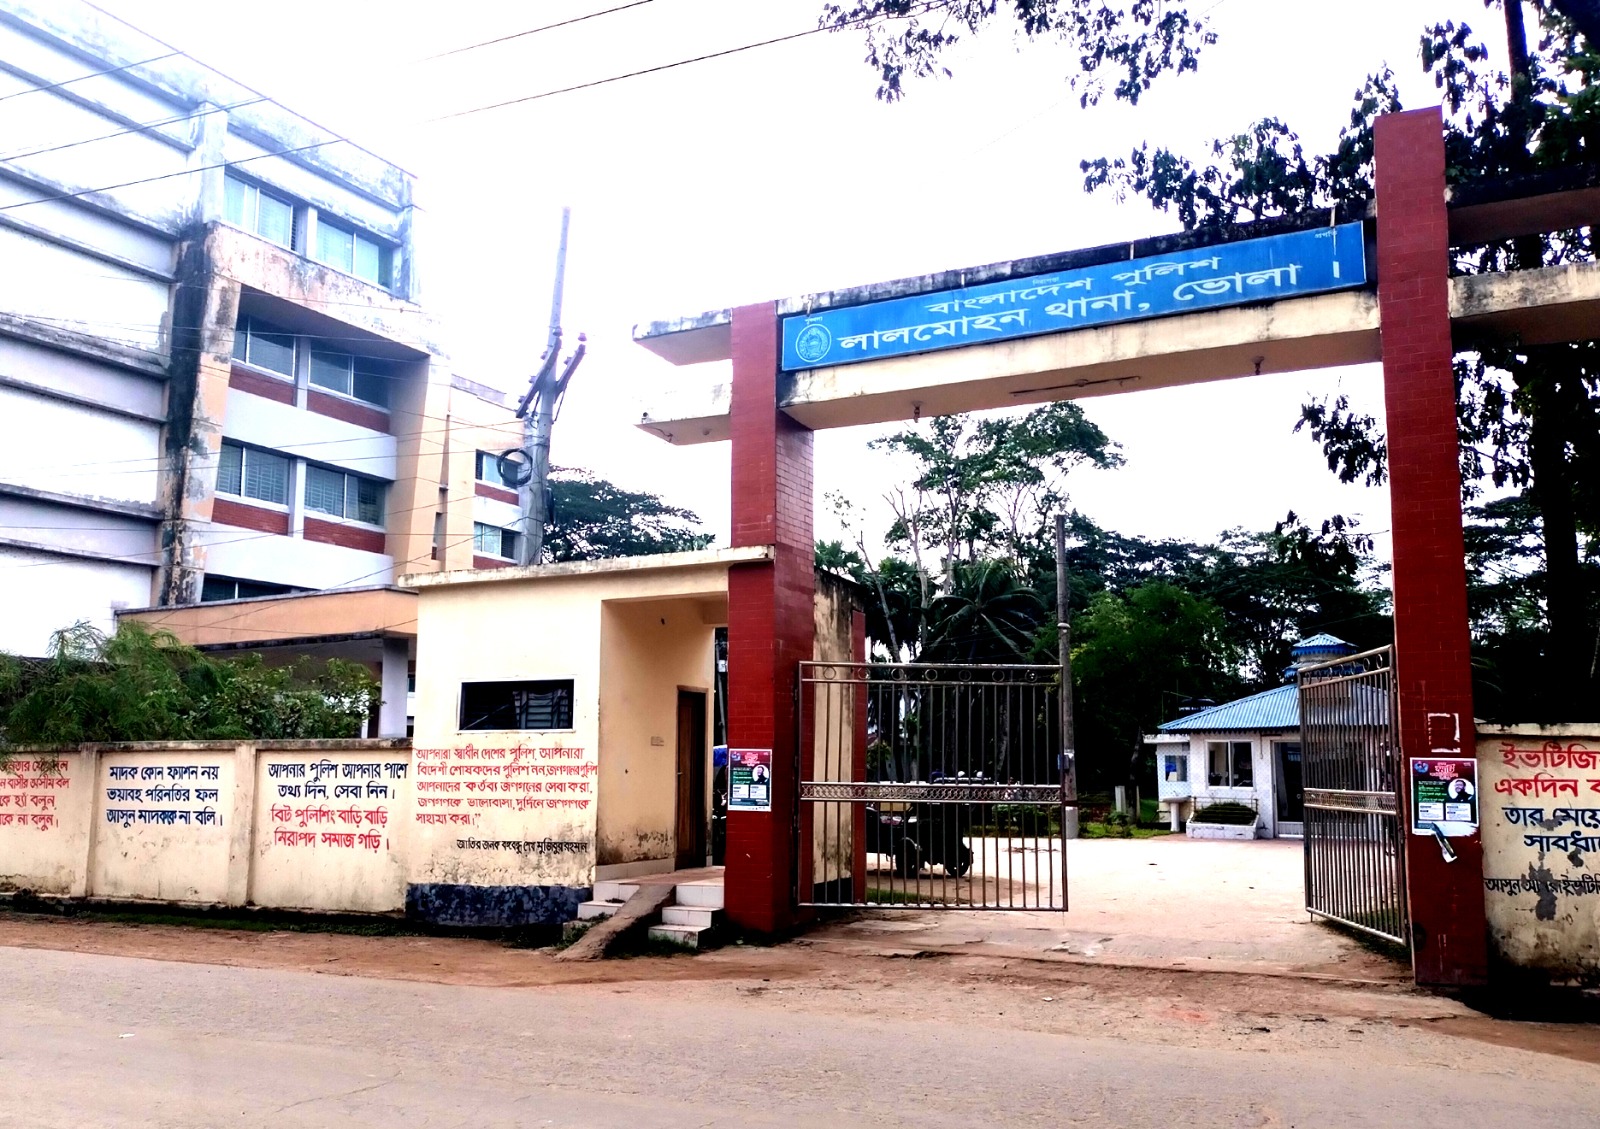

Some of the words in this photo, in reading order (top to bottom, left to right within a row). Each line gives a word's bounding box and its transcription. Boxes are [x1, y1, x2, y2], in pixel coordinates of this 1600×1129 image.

[924, 277, 1094, 314] বাংলাদেশ
[1112, 256, 1223, 286] পুলিশ
[836, 307, 1030, 351] লালমোহন
[1044, 289, 1150, 319] থানা,
[1173, 263, 1304, 301] ভোলা
[416, 749, 450, 760] আপনারা
[454, 743, 479, 759] স্বাধীন
[481, 748, 506, 760] দেশের
[539, 748, 585, 760] আপনারা
[1499, 741, 1600, 770] ইভটিজি
[110, 766, 139, 780] মাদক
[141, 767, 164, 780] কোন
[167, 766, 199, 780] ফ্যাশন
[201, 766, 220, 780] নয়
[268, 763, 305, 779] আপনার
[310, 759, 339, 782] পুলিশ
[342, 763, 381, 779] আপনার
[384, 762, 408, 779] পাশে
[417, 761, 447, 775] বিদেশী
[450, 765, 501, 776] শোষকদের
[503, 761, 530, 779] পুলিশ
[277, 785, 301, 798] তথ্য
[304, 780, 329, 800] দিন,
[334, 785, 362, 799] সেবা
[366, 780, 388, 799] নিন
[417, 782, 461, 792] আপনাদের
[463, 779, 498, 792] কর্তব্য
[545, 781, 567, 793] সেবা
[1495, 772, 1579, 798] একদিন
[106, 788, 143, 803] ভয়াবহ
[195, 788, 219, 802] ফল
[17, 814, 29, 825] না
[106, 809, 136, 828] আসুন
[179, 810, 191, 824] না
[270, 803, 292, 822] বিট
[295, 804, 336, 828] পুলিশিং
[336, 804, 362, 828] বাড়ি
[363, 806, 388, 828] বাড়ি
[1502, 807, 1545, 828] তার
[274, 826, 317, 848] নিরাপদ
[321, 832, 356, 848] সমাজ
[457, 837, 481, 850] জাতির
[482, 840, 500, 851] জনক
[1485, 879, 1521, 896] আসুন
